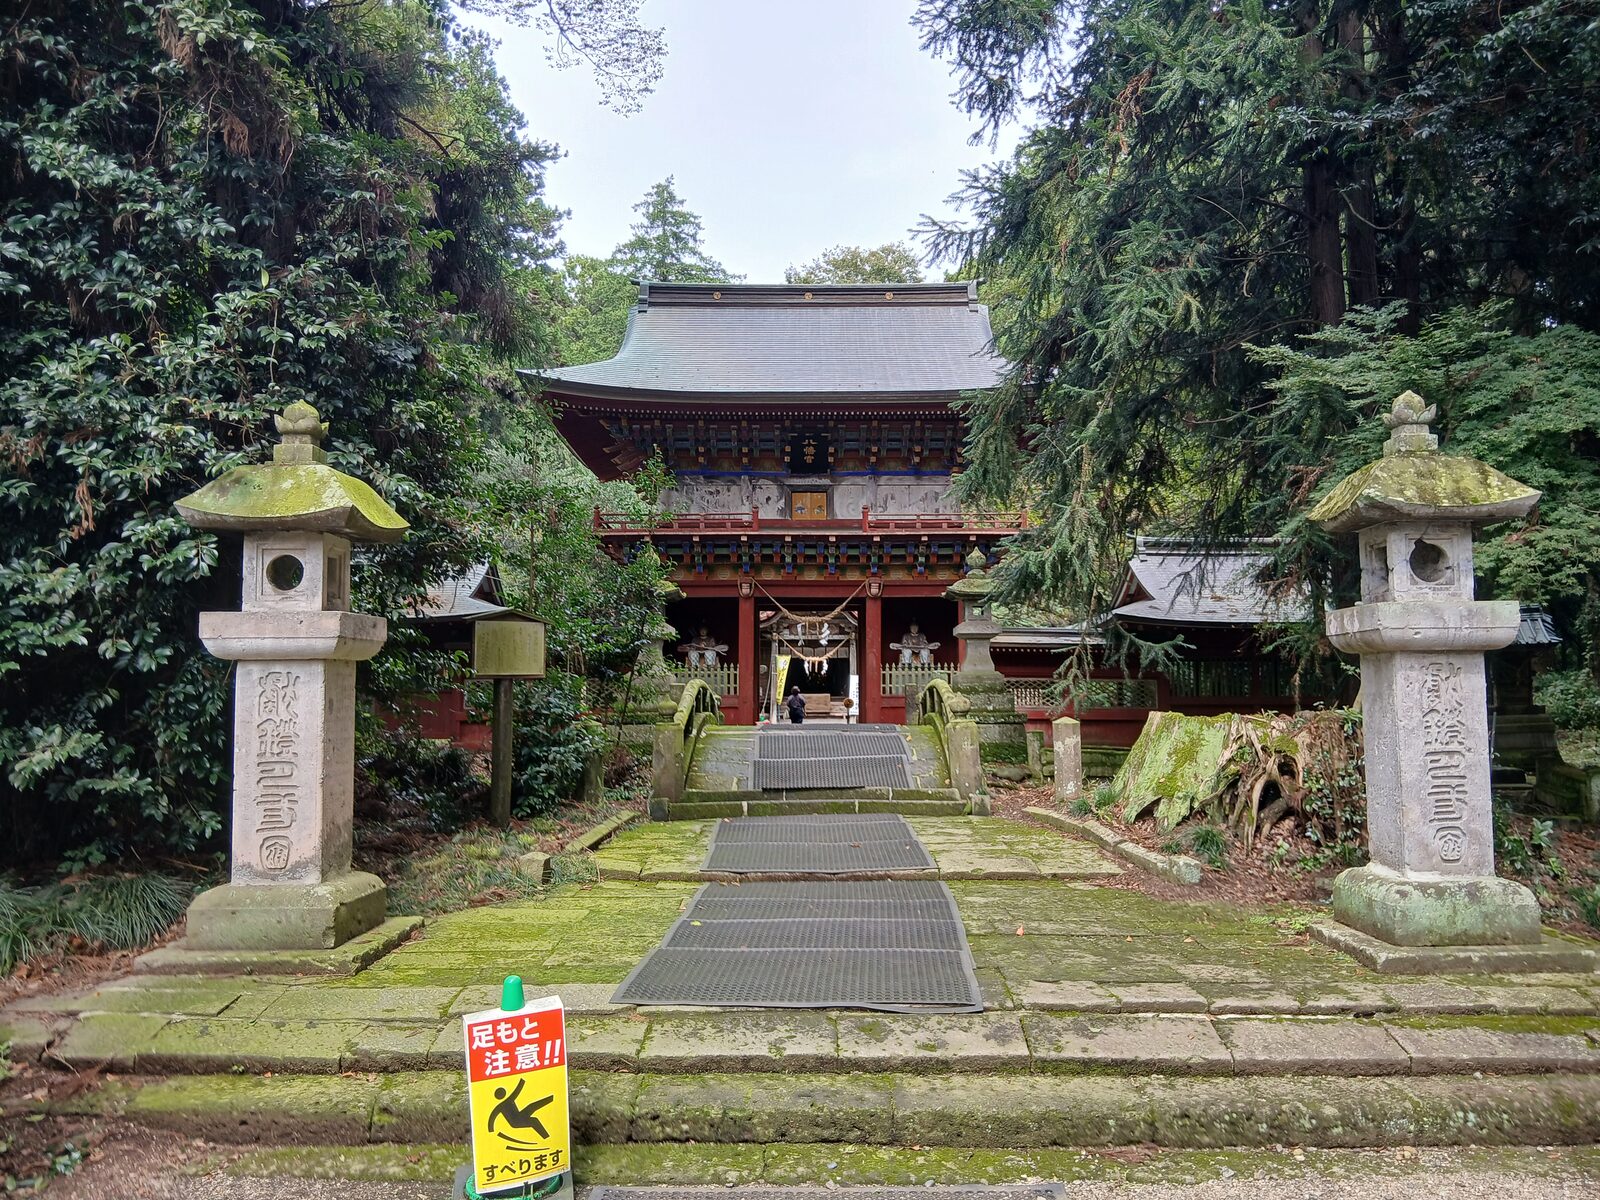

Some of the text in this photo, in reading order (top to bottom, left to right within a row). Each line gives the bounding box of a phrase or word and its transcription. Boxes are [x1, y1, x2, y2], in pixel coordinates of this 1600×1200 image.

[472, 1017, 540, 1050] 足もと
[484, 1038, 562, 1076] 注意!!
[482, 1149, 563, 1182] すべります
